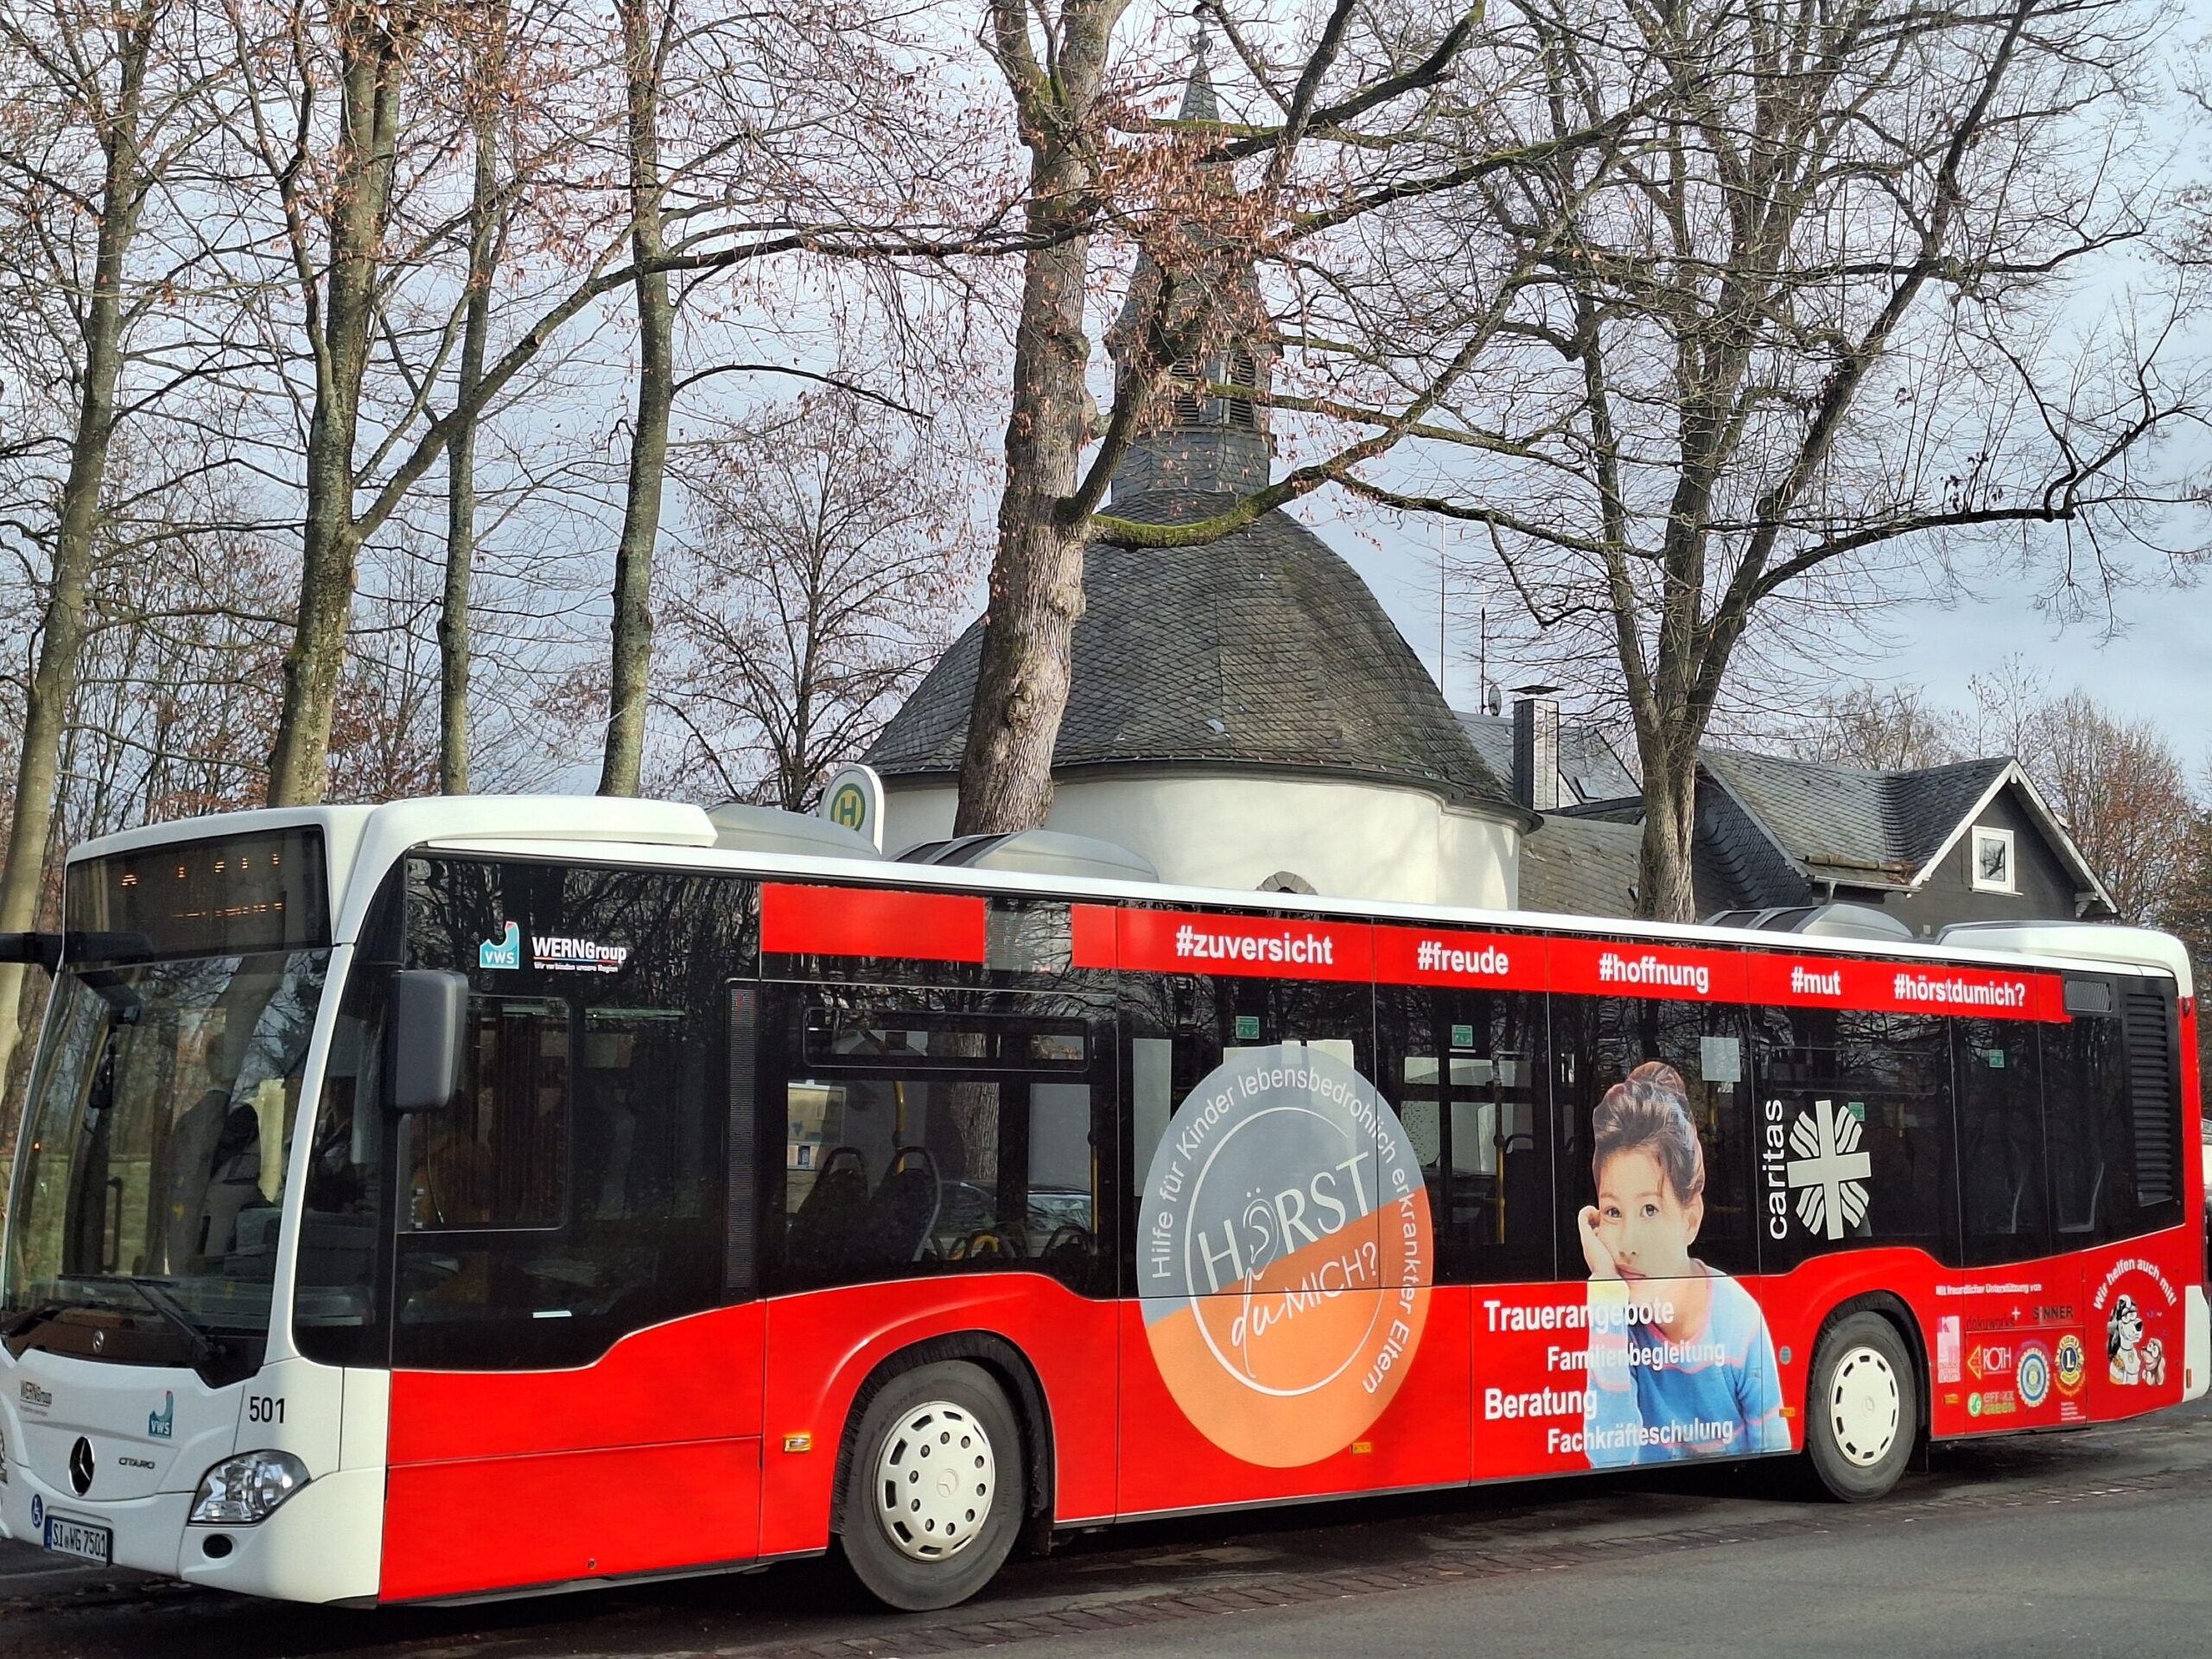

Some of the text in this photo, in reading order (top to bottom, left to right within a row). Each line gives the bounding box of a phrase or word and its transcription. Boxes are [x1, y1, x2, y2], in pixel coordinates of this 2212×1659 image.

[840, 796, 857, 827] H
[485, 951, 515, 964] VWS
[531, 937, 626, 964] WERNGroup
[1176, 925, 1333, 965] #zuversicht
[1417, 941, 1509, 975] #freude
[1599, 952, 1709, 994] #hoffnung
[1791, 966, 1840, 995] #mut
[1894, 973, 2025, 1007] #hörstdumich?
[1763, 1099, 1788, 1241] caritas
[1152, 1067, 1422, 1395] Hilfe für Kinder lebensbedrohlich erkrankter Eltern
[1284, 1242, 1377, 1320] MICH?
[2094, 1282, 2108, 1310] Wir
[2106, 1259, 2135, 1286] helfen
[2137, 1259, 2160, 1281] auch
[1484, 1299, 1675, 1334] Trauerangebote
[2032, 1306, 2074, 1321] SINNER
[1548, 1340, 1726, 1372] Familienbegleitung
[1983, 1346, 2012, 1371] ROTH
[249, 1396, 285, 1424] 501
[1484, 1387, 1598, 1421] Beratung
[150, 1420, 170, 1434] VWS
[1548, 1418, 1733, 1455] Fachkräfteschulung
[69, 1529, 80, 1552] WG
[84, 1531, 106, 1557] 7501
